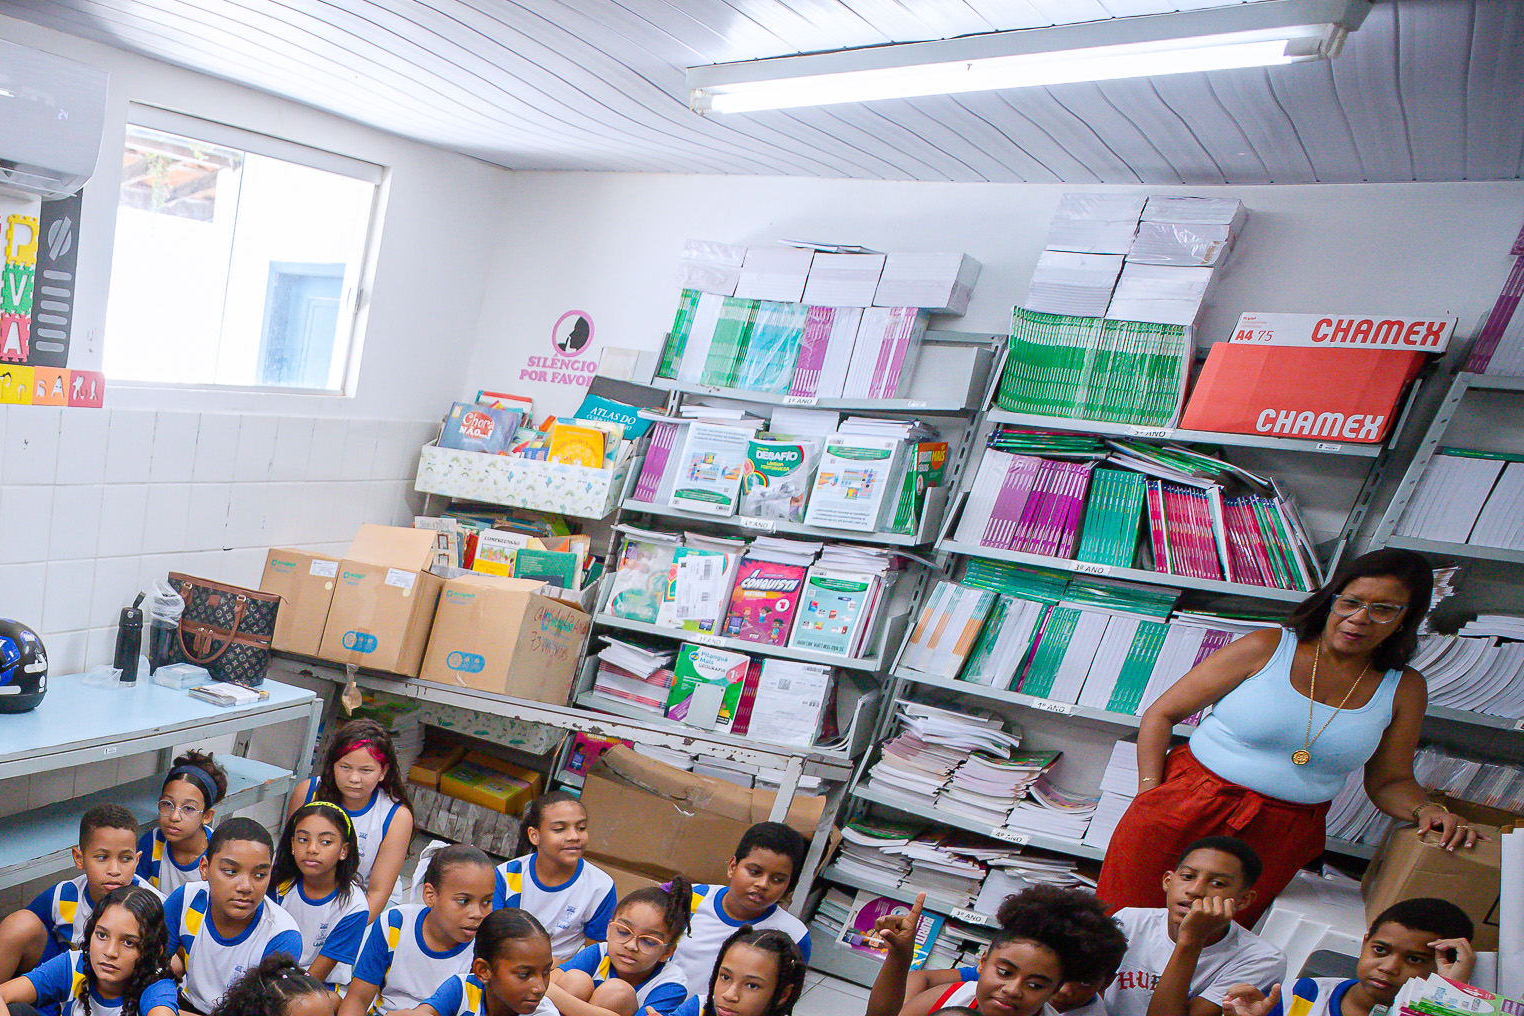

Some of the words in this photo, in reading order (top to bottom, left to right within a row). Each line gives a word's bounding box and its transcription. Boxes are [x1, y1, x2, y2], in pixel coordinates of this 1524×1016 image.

[11, 222, 33, 257] P
[9, 272, 29, 306] V
[3, 321, 21, 354] A
[1235, 329, 1253, 341] A4
[1258, 330, 1274, 342] 75
[1311, 318, 1446, 347] CHAMEX
[527, 354, 597, 373] SILÊNCIO
[519, 368, 547, 383] POR
[463, 412, 495, 430] Chora
[590, 406, 620, 420] ATLAS
[620, 414, 636, 425] DO
[1255, 408, 1384, 440] CHAMEX
[750, 568, 761, 578] A
[1085, 566, 1104, 575] ANO
[741, 578, 799, 591] CONQUISTA
[1047, 704, 1066, 713] ANO
[1005, 834, 1023, 843] ANO
[965, 913, 982, 922] ANO
